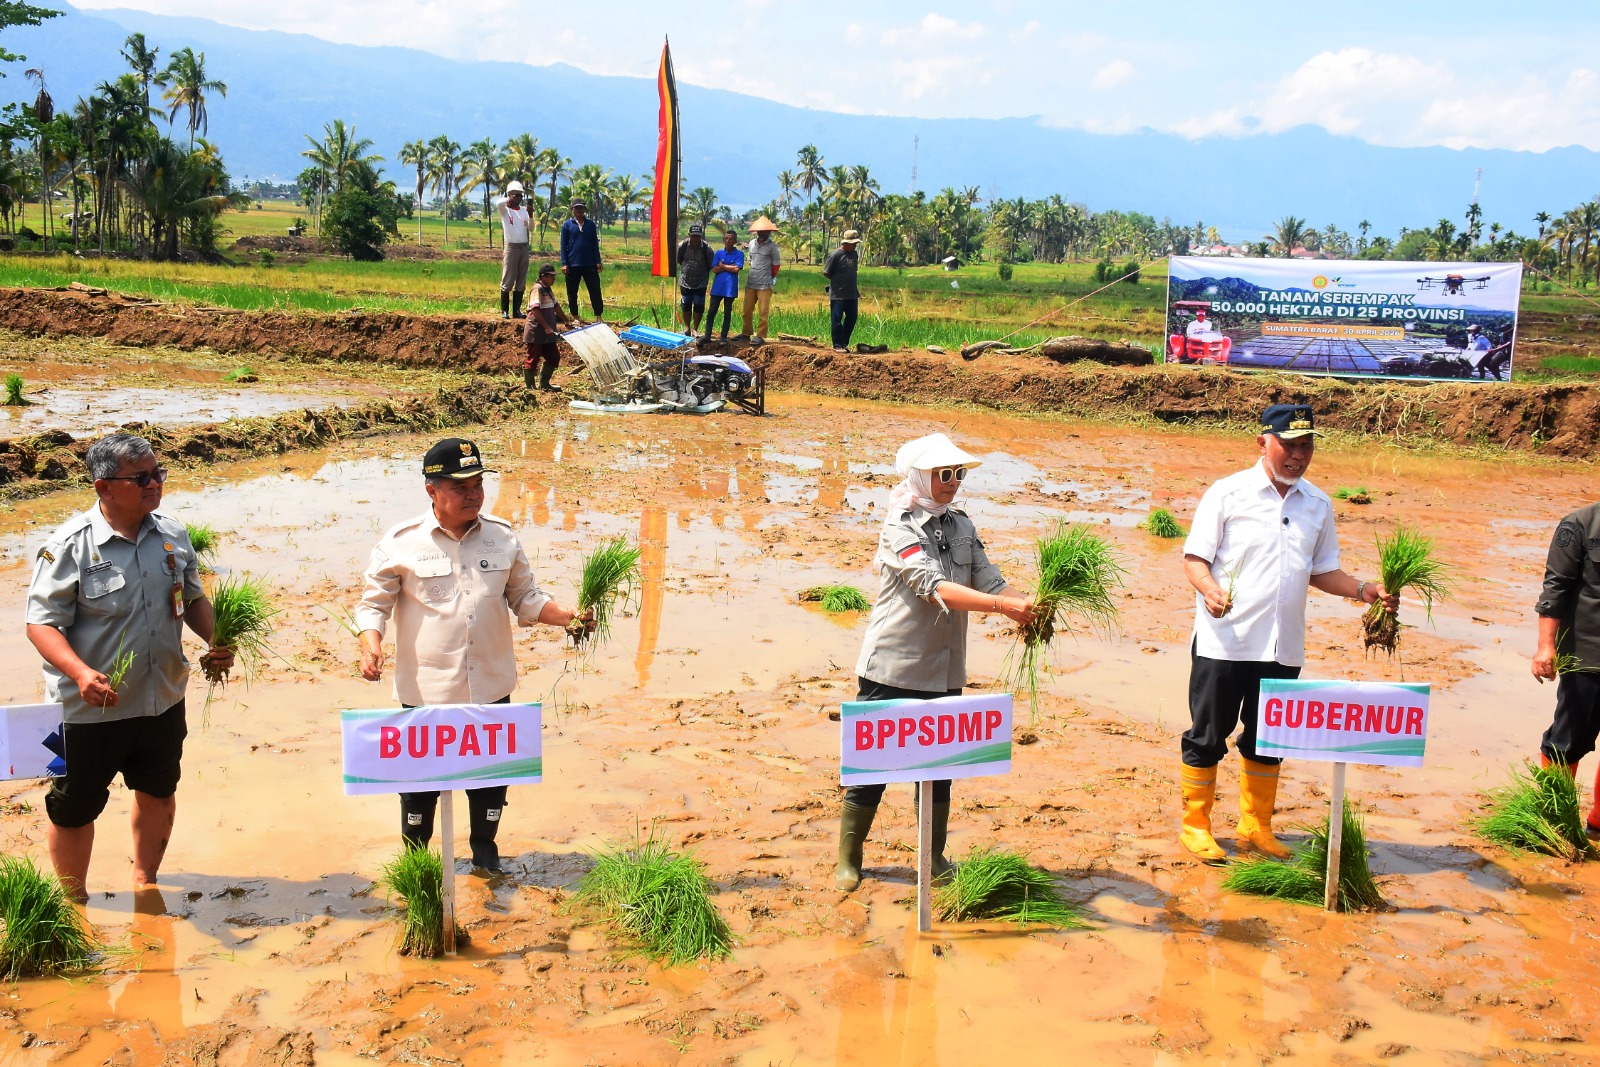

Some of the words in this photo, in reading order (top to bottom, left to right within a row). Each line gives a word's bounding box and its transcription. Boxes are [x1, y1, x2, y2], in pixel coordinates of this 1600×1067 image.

[1211, 301, 1266, 314] 50.000
[1269, 303, 1334, 316] HEKTAR
[1337, 306, 1354, 317] DI
[1357, 306, 1378, 318] 25
[1382, 308, 1465, 321] PROVINSI
[1259, 290, 1319, 303] TANAM
[1322, 292, 1413, 306] SEREMPAK
[1265, 325, 1309, 333] SUMATERA
[855, 710, 1003, 751] BPPSDMP
[1264, 698, 1424, 736] GUBERNUR
[379, 723, 516, 759] BUPATI
